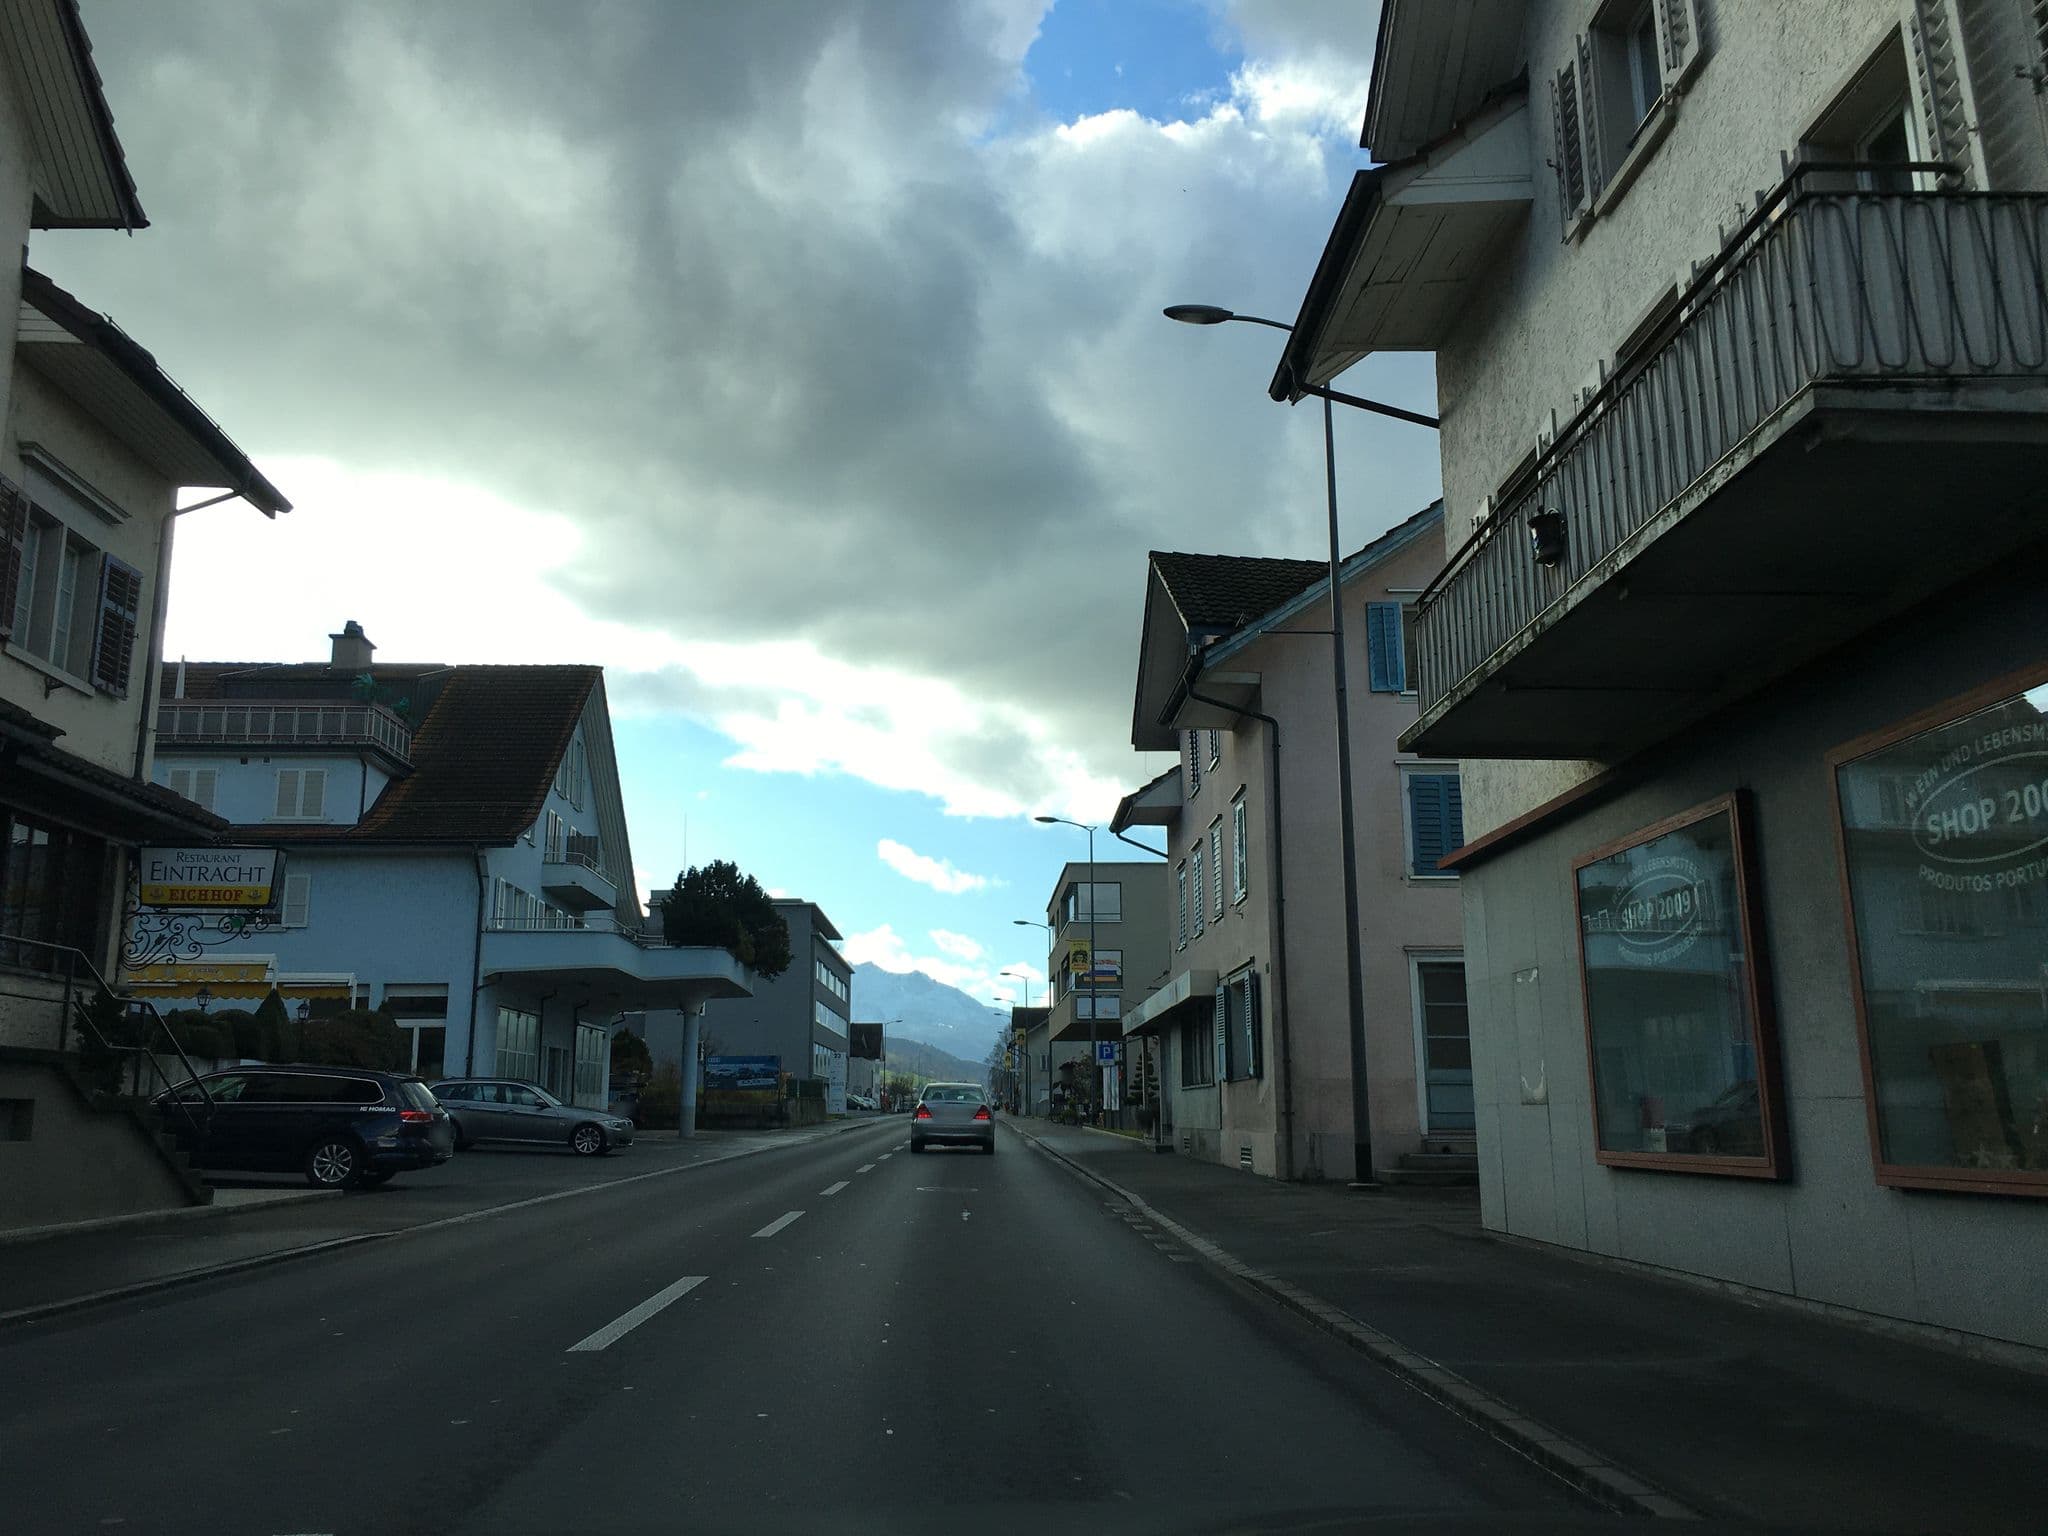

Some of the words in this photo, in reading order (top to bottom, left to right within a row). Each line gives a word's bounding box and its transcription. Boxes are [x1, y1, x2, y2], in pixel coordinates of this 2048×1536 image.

[1943, 745, 1972, 772] UND
[1927, 798, 1996, 845] SHOP
[176, 851, 241, 863] RESTAURANT
[151, 861, 266, 882] EINTRACHT
[1918, 863, 1992, 892] PRODUTOS
[168, 888, 243, 902] EICHHOF
[1621, 901, 1654, 929] SHOP
[1658, 889, 1691, 921] 2009
[1103, 1046, 1111, 1058] P
